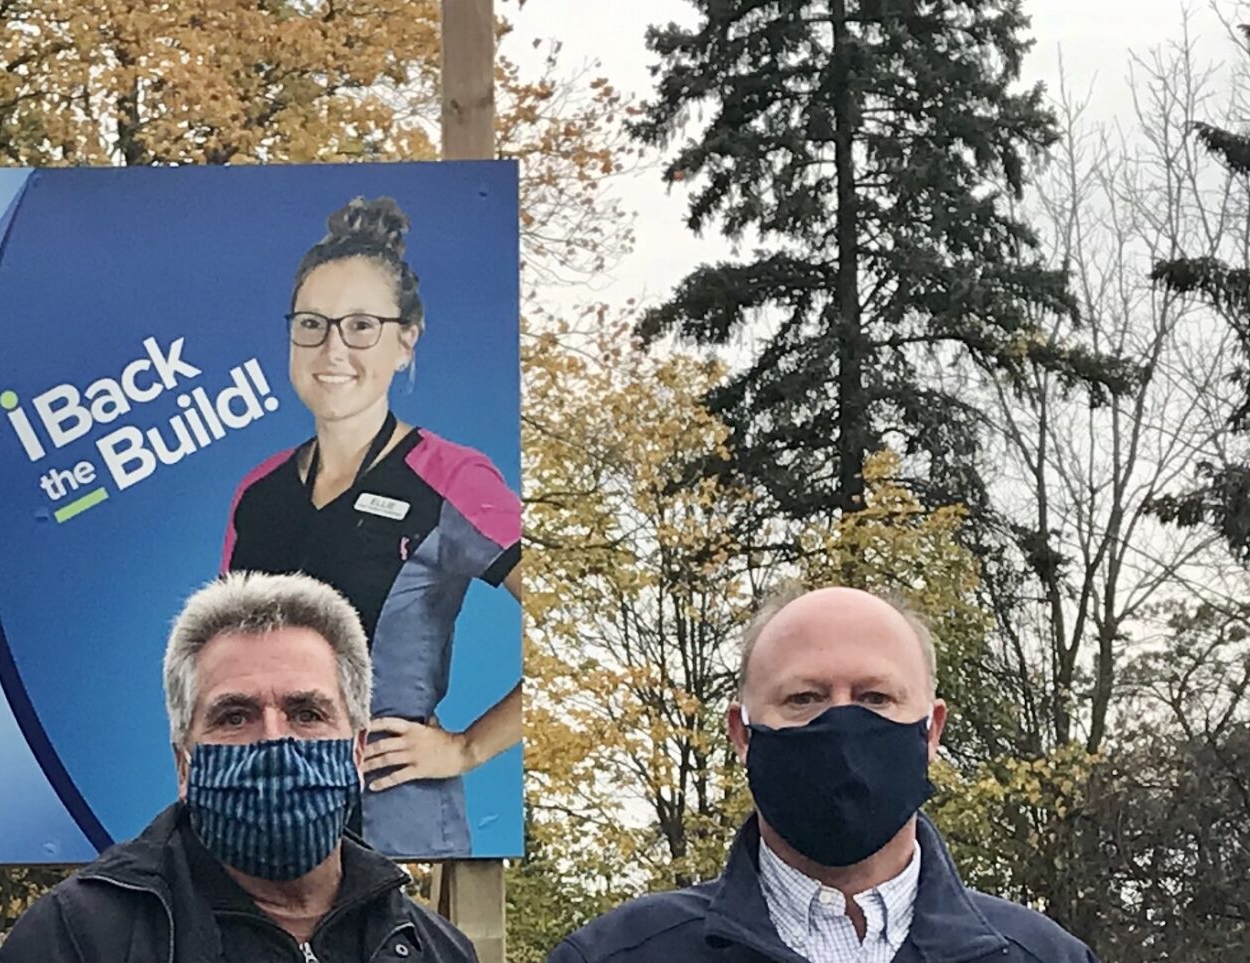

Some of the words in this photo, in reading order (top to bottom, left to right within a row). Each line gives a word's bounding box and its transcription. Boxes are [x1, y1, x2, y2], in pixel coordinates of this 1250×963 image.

[32, 336, 202, 448] Back
[40, 461, 97, 500] the
[95, 358, 279, 490] Build!
